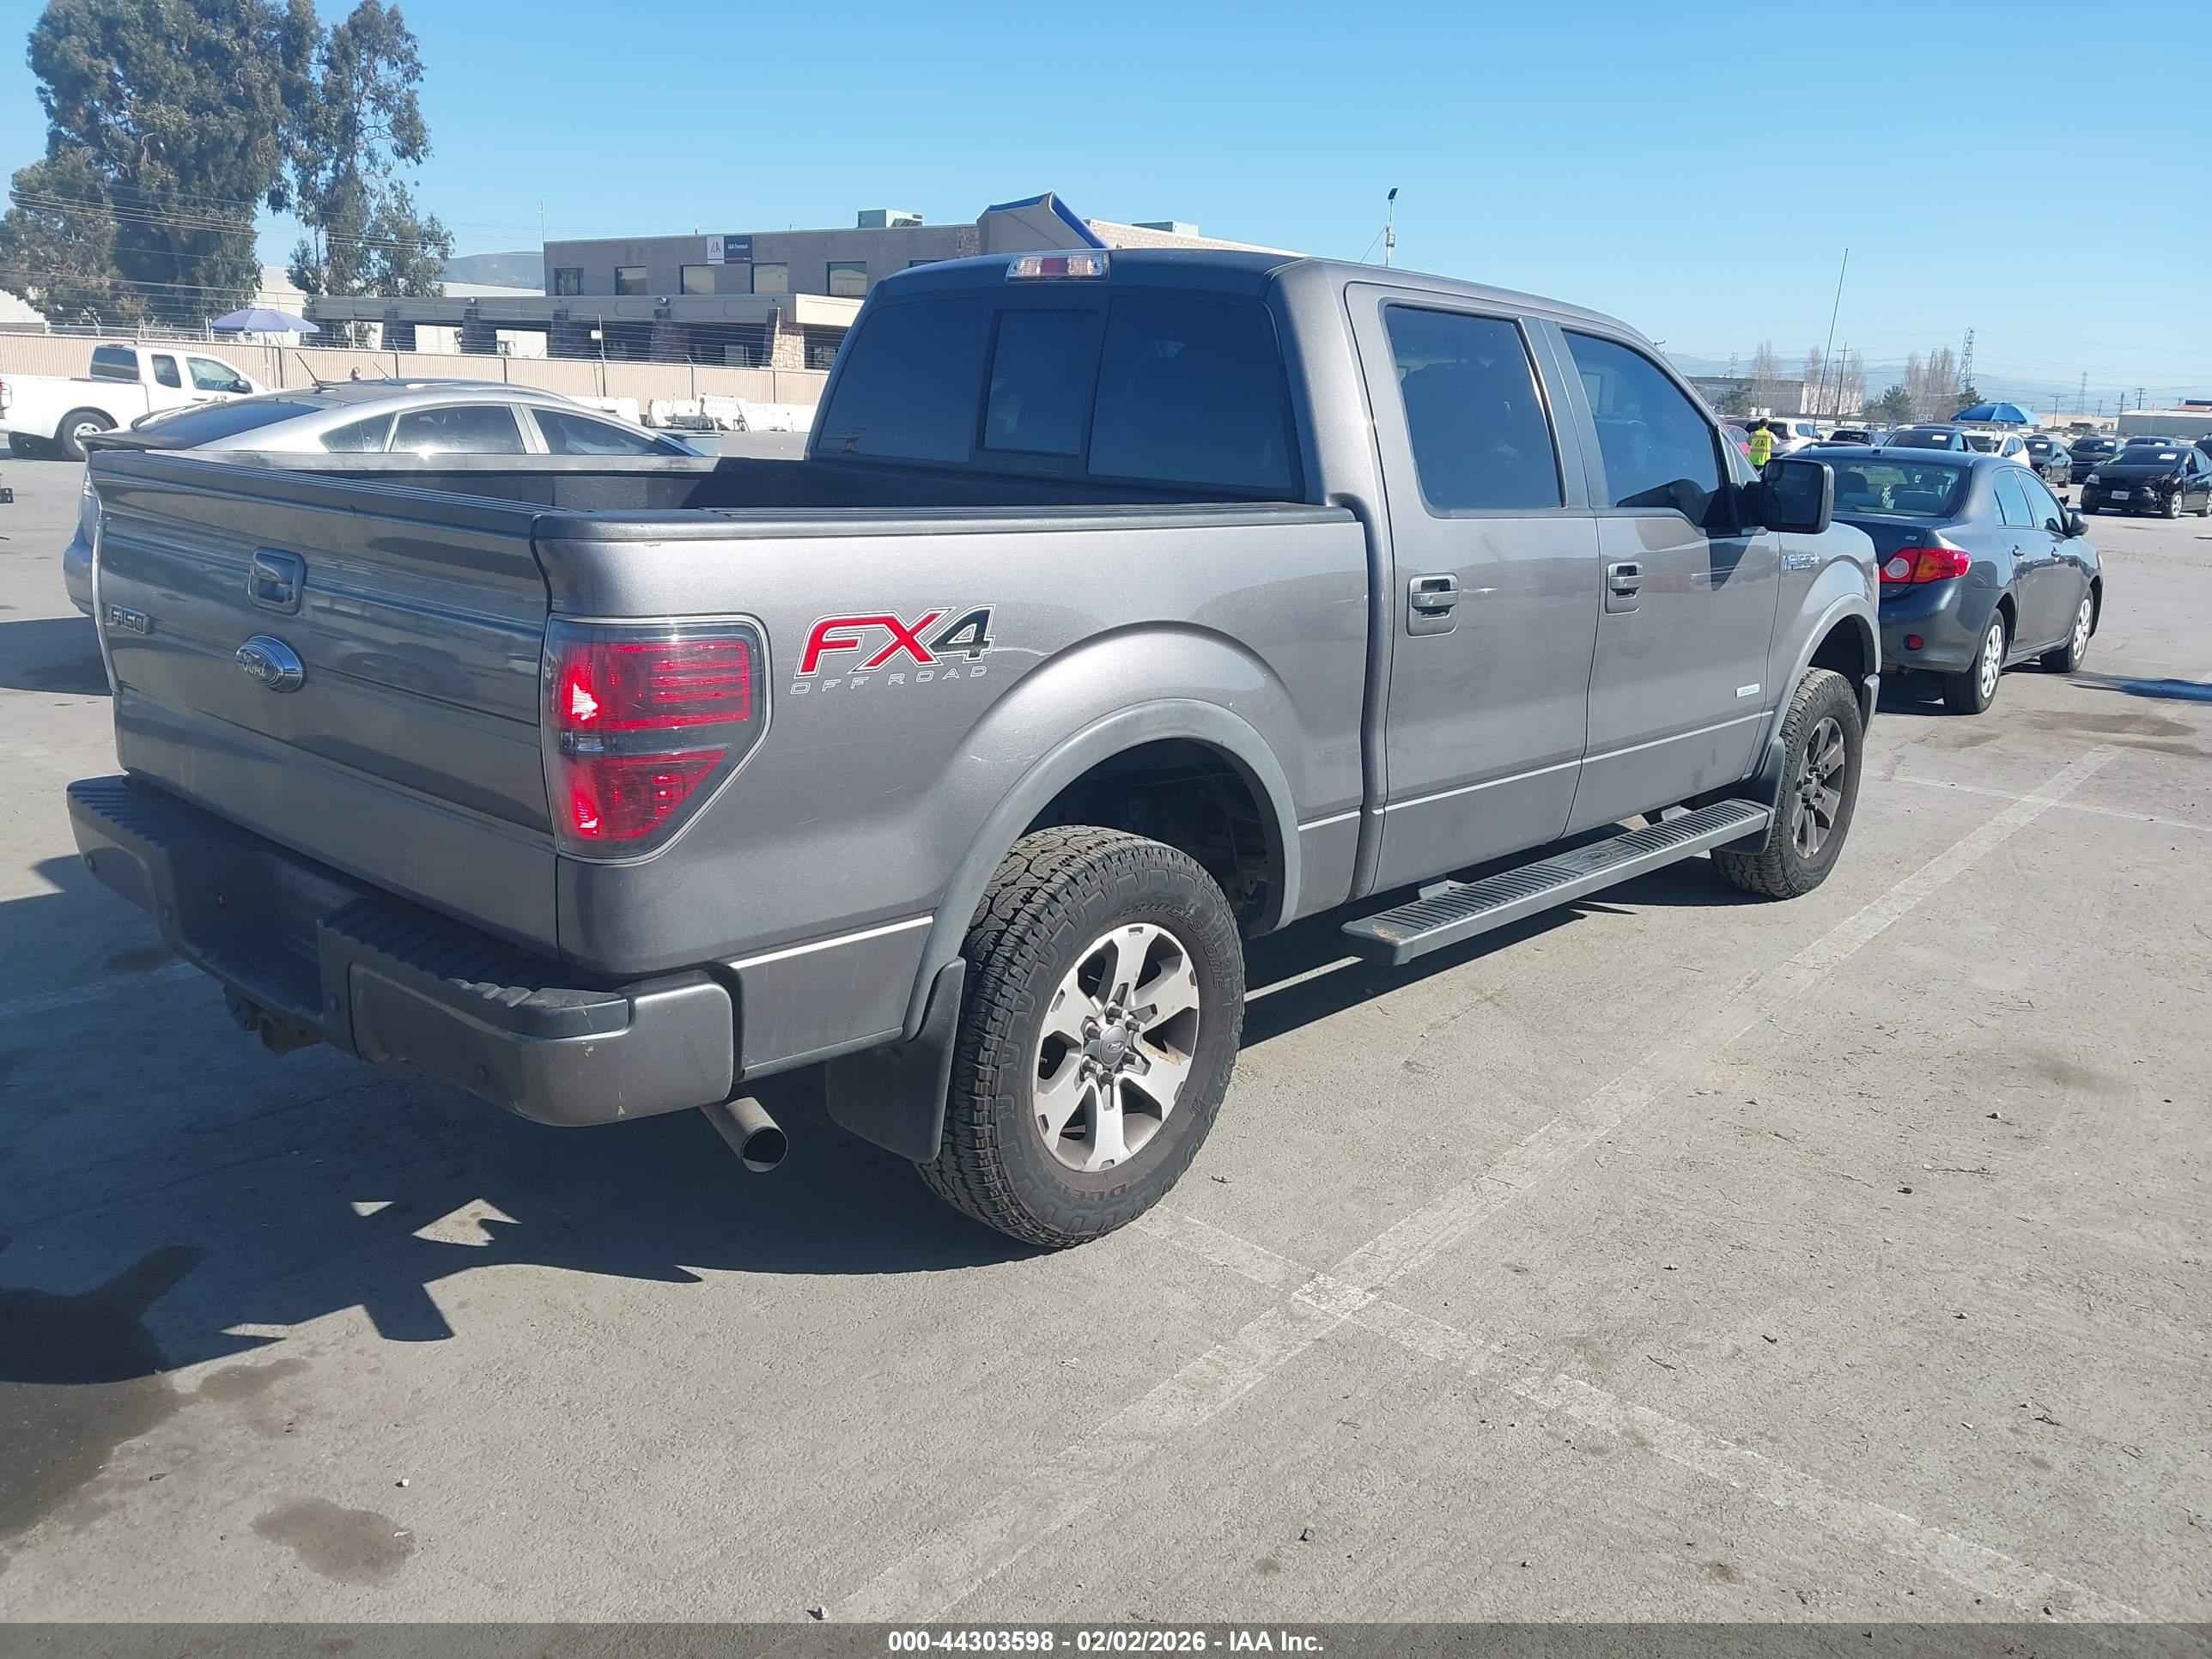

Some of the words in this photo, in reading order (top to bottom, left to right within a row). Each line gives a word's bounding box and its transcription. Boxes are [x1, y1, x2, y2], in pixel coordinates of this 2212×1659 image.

[793, 604, 996, 679] FX4
[241, 649, 268, 678] Ford
[790, 676, 870, 695] OFF
[887, 665, 988, 686] ROAD
